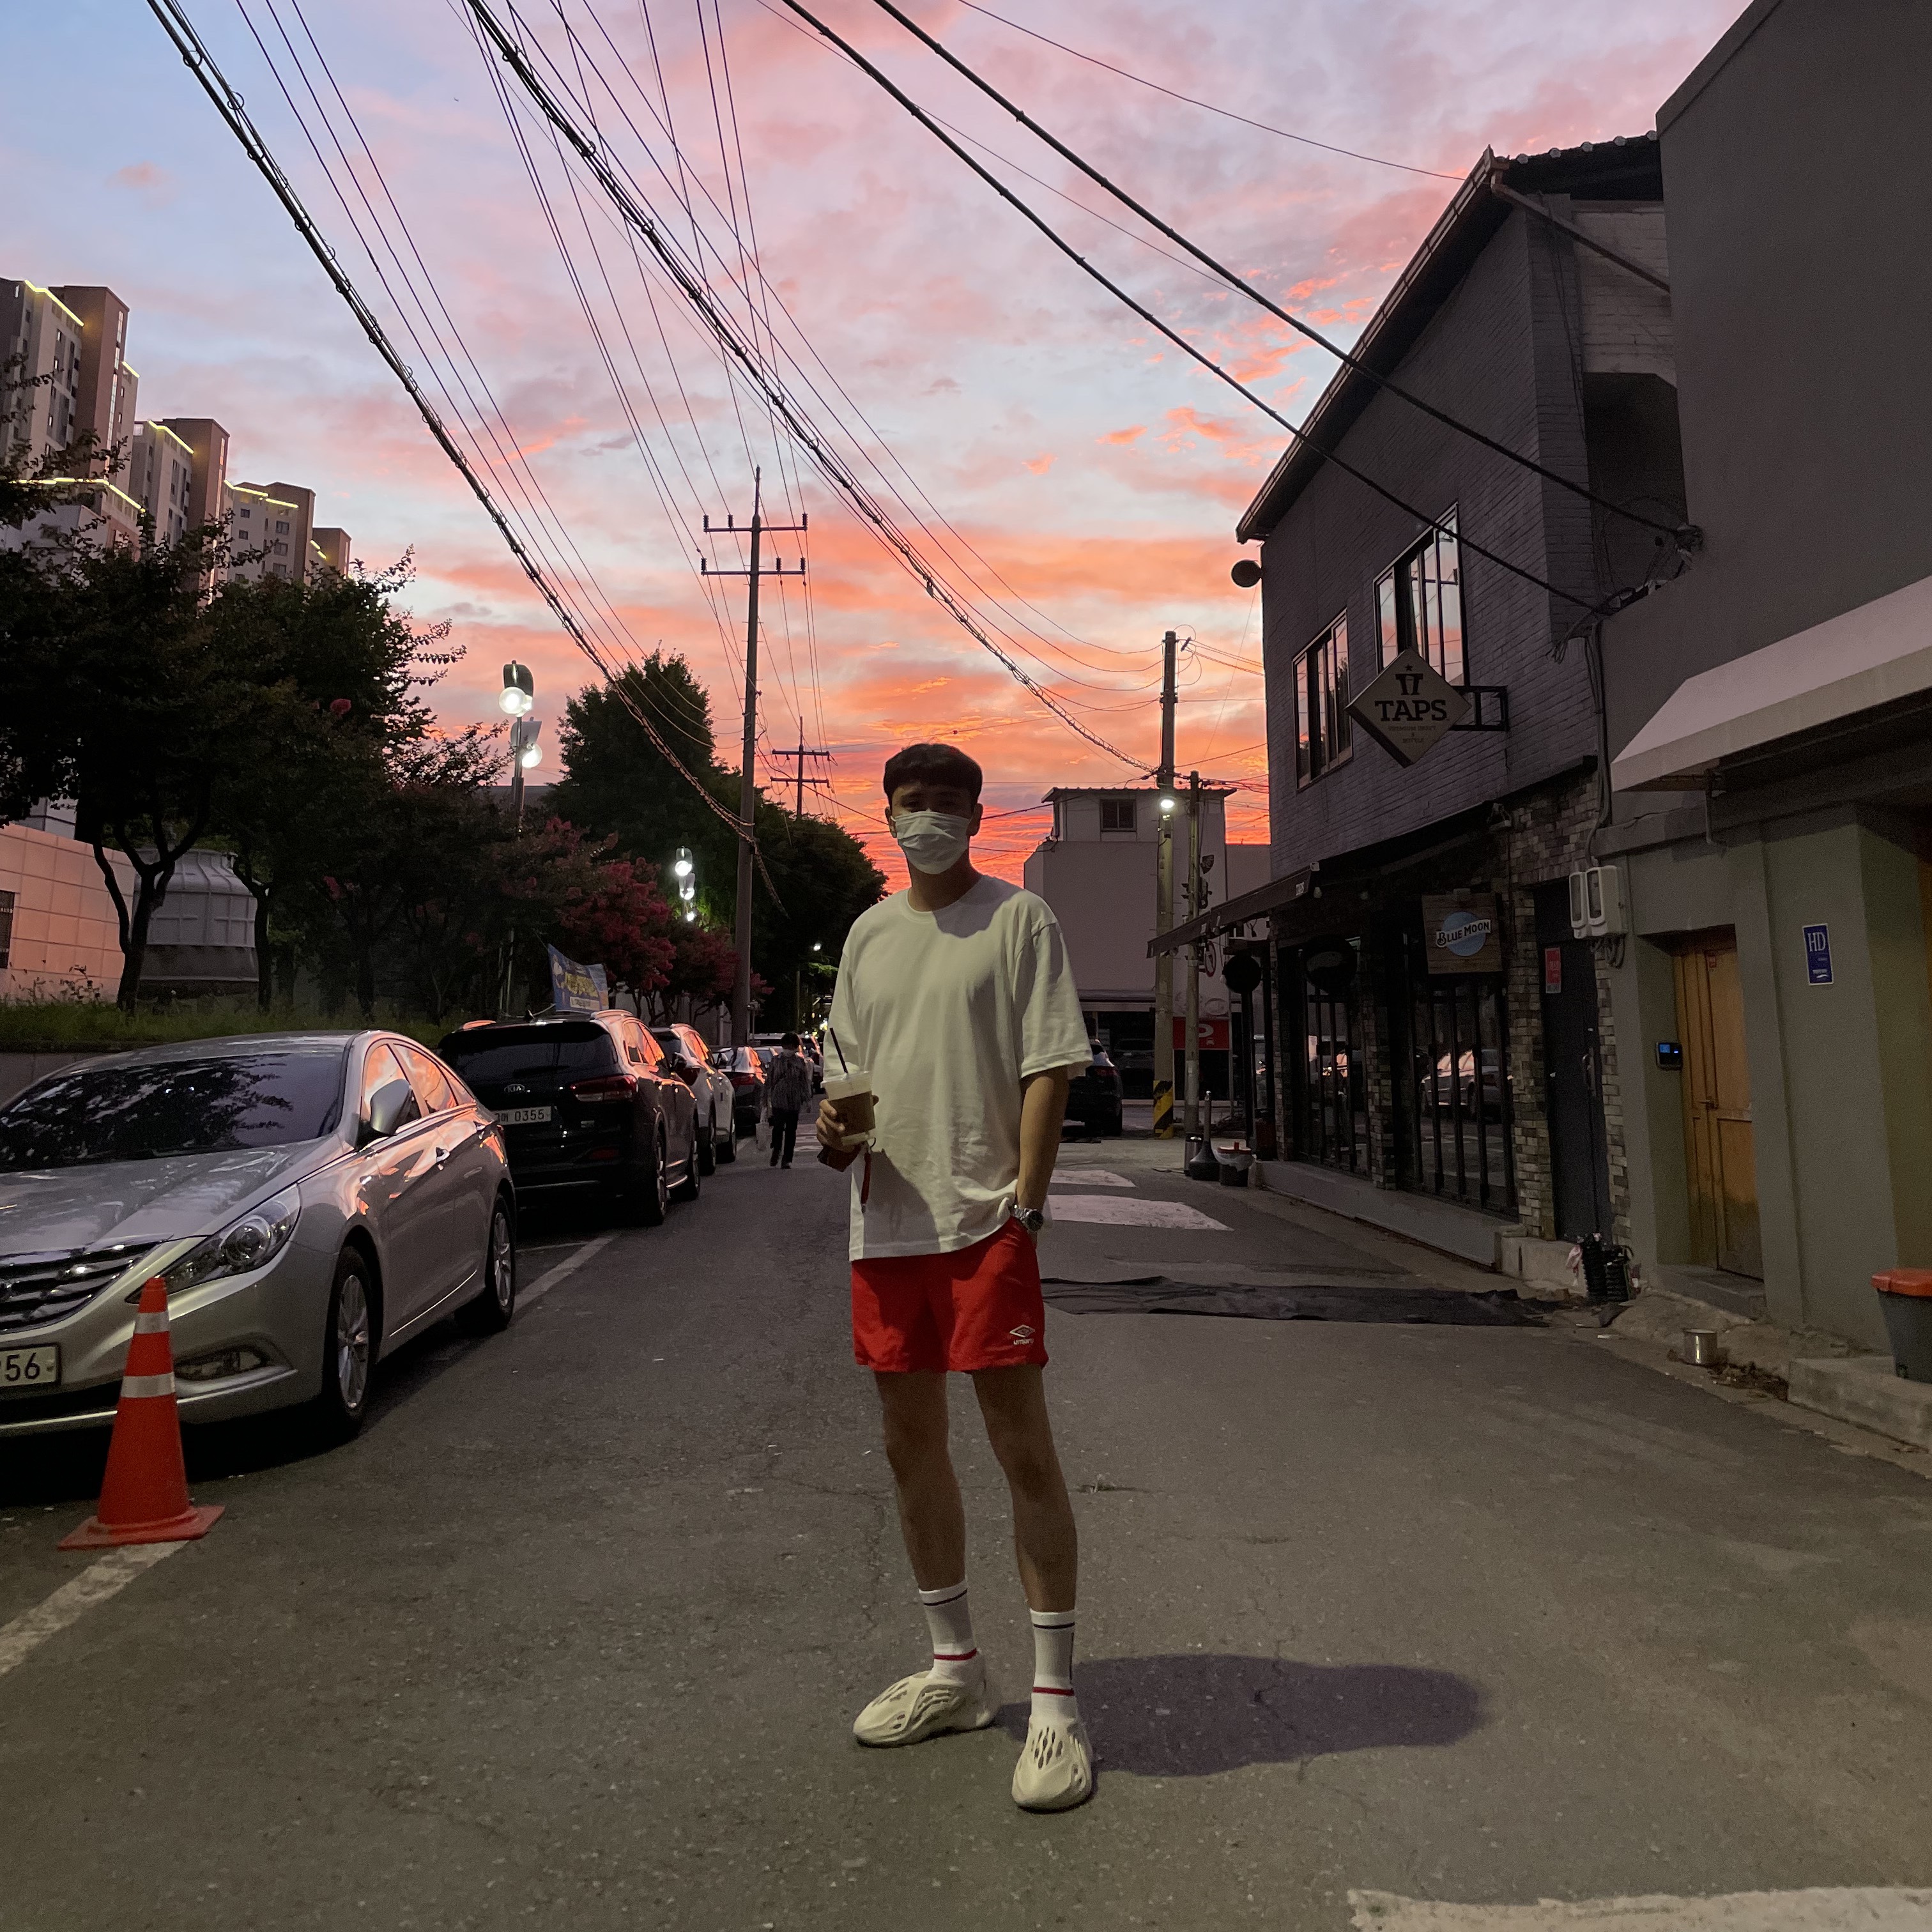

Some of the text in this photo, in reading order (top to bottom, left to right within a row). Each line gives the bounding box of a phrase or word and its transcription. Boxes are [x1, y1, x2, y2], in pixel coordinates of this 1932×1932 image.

[1374, 700, 1448, 721] TAPS
[1437, 921, 1490, 946] BLUE MOON
[1807, 932, 1827, 952] HD
[514, 1109, 544, 1122] 0355
[0, 1352, 40, 1381] 56
